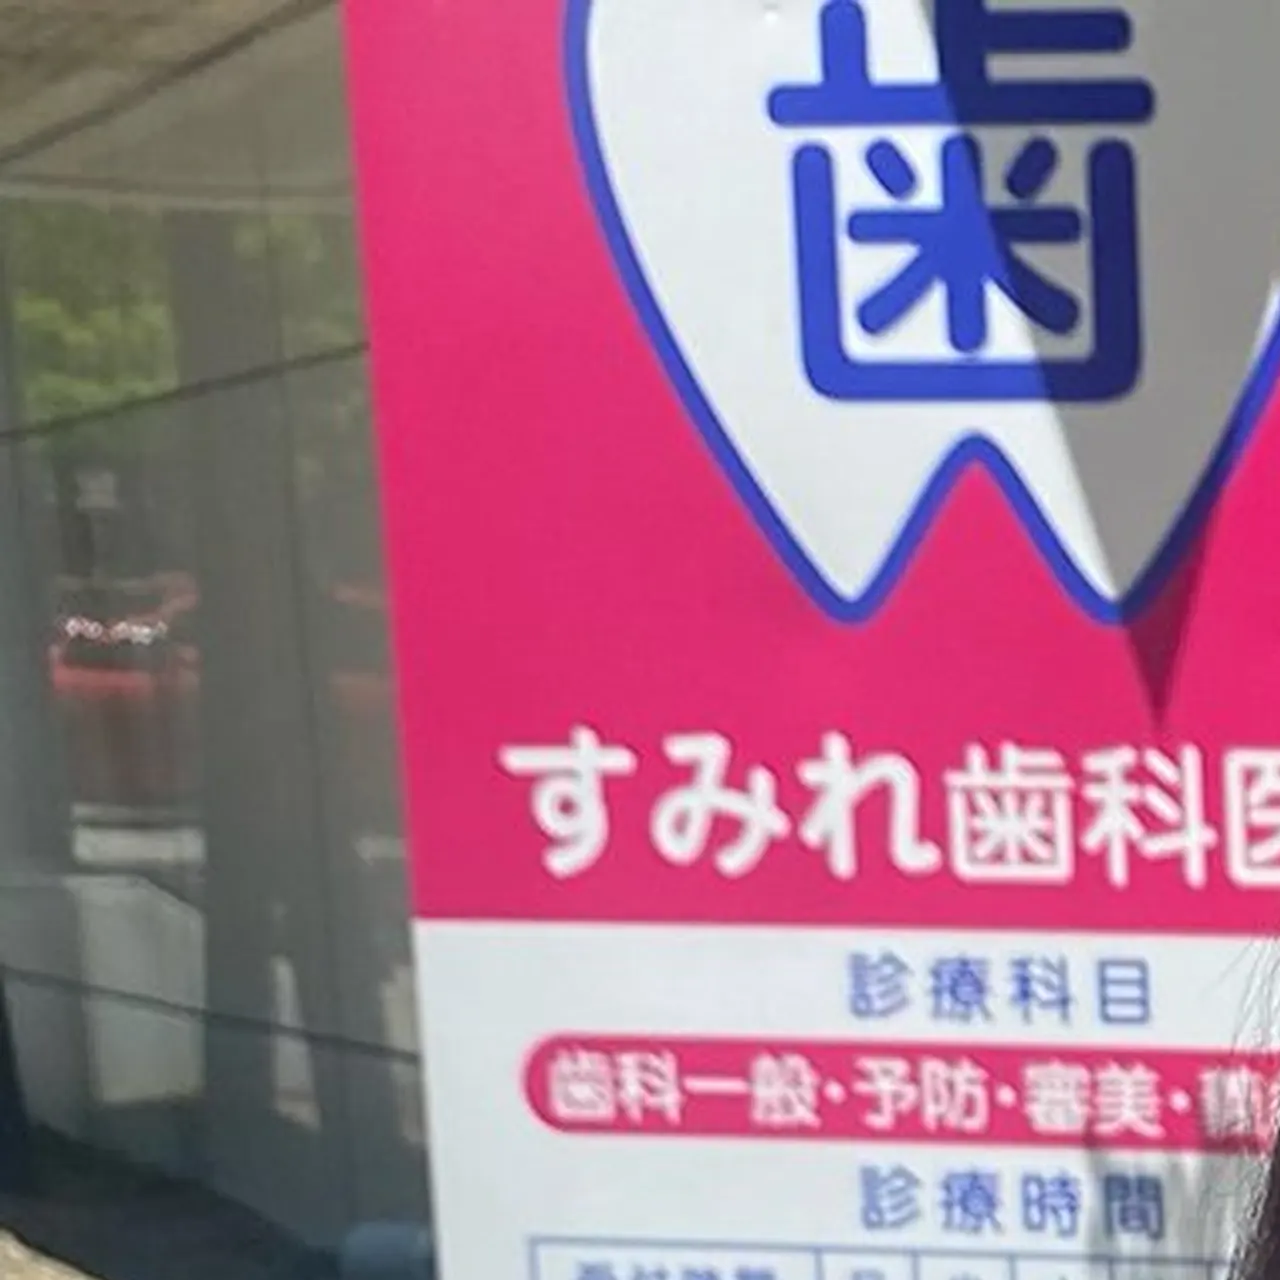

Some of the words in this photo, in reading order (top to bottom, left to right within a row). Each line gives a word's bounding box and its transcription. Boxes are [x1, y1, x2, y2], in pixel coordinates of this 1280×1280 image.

[767, 0, 1155, 401] 歯
[847, 949, 1153, 1026] 診療科目
[859, 1163, 1166, 1241] 診療時間
